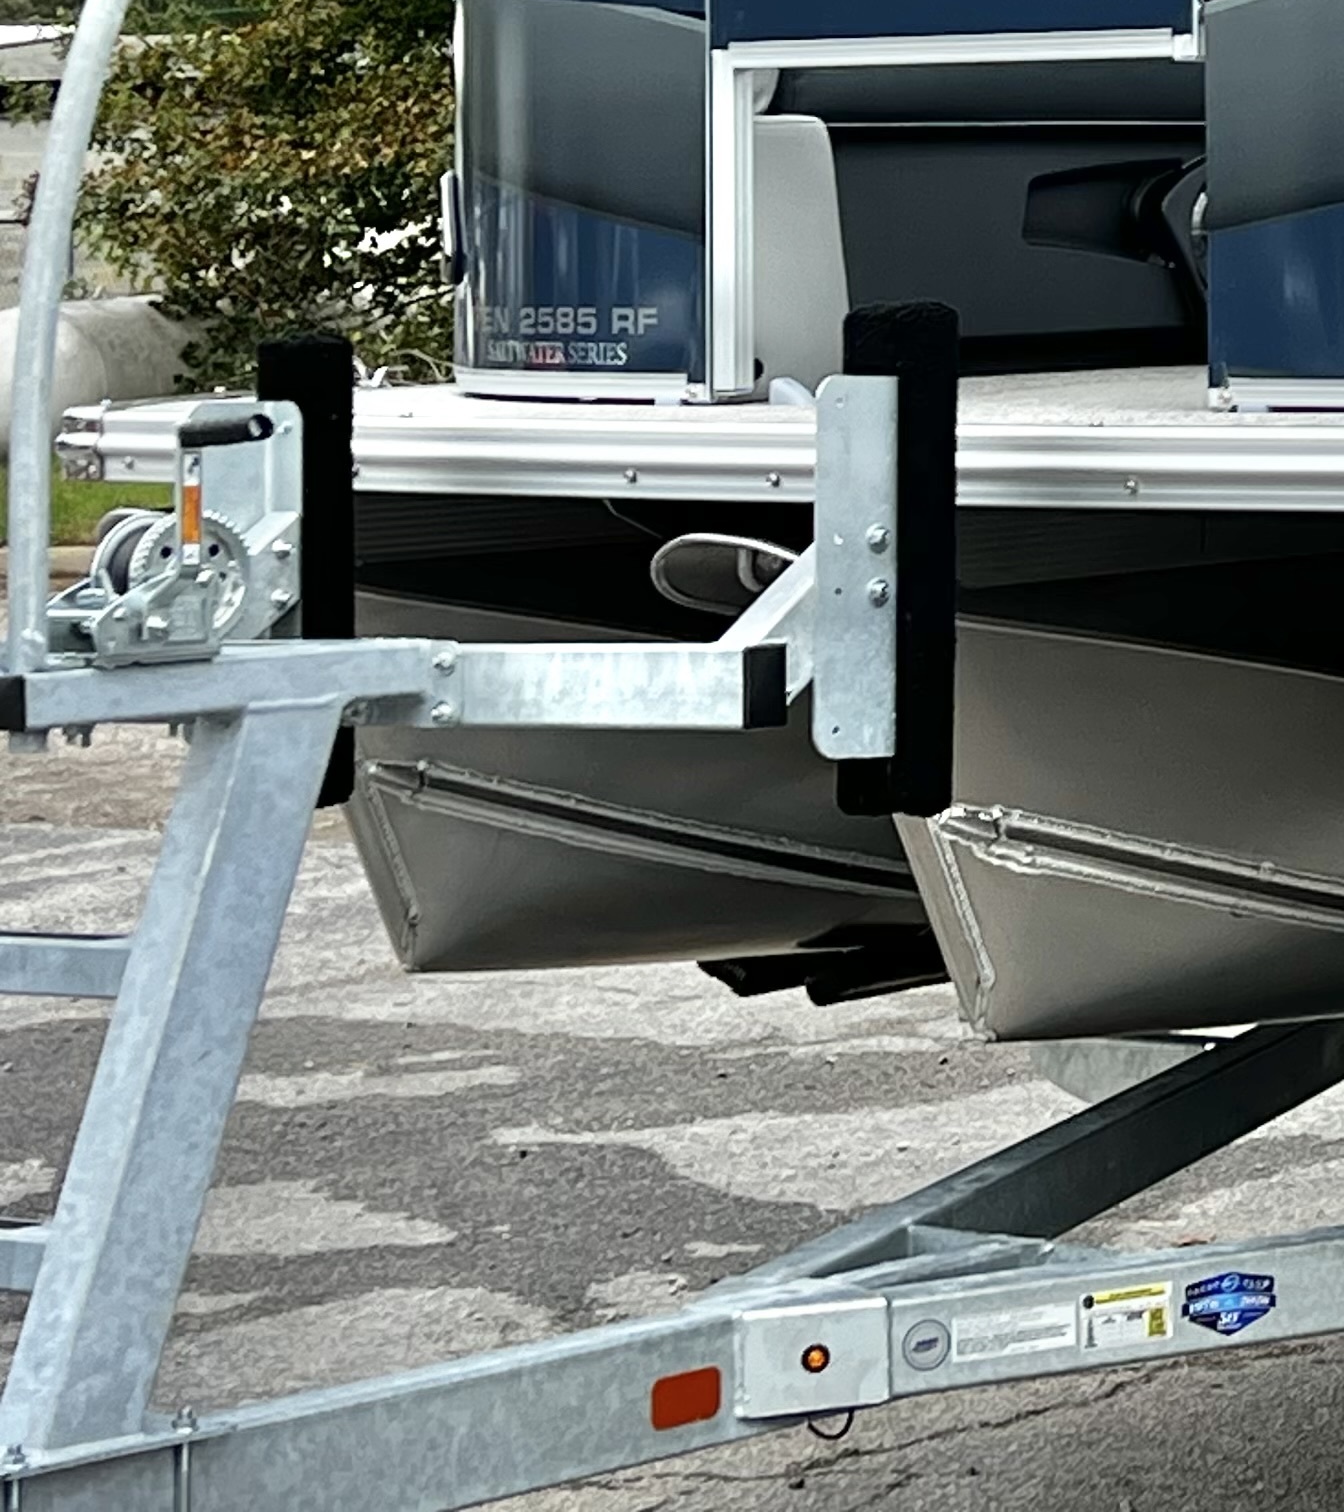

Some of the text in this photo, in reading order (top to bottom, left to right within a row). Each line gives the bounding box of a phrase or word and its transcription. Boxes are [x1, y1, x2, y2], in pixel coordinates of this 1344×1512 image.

[519, 306, 597, 335] 2585
[611, 306, 659, 336] RF
[567, 341, 628, 366] SERIES
